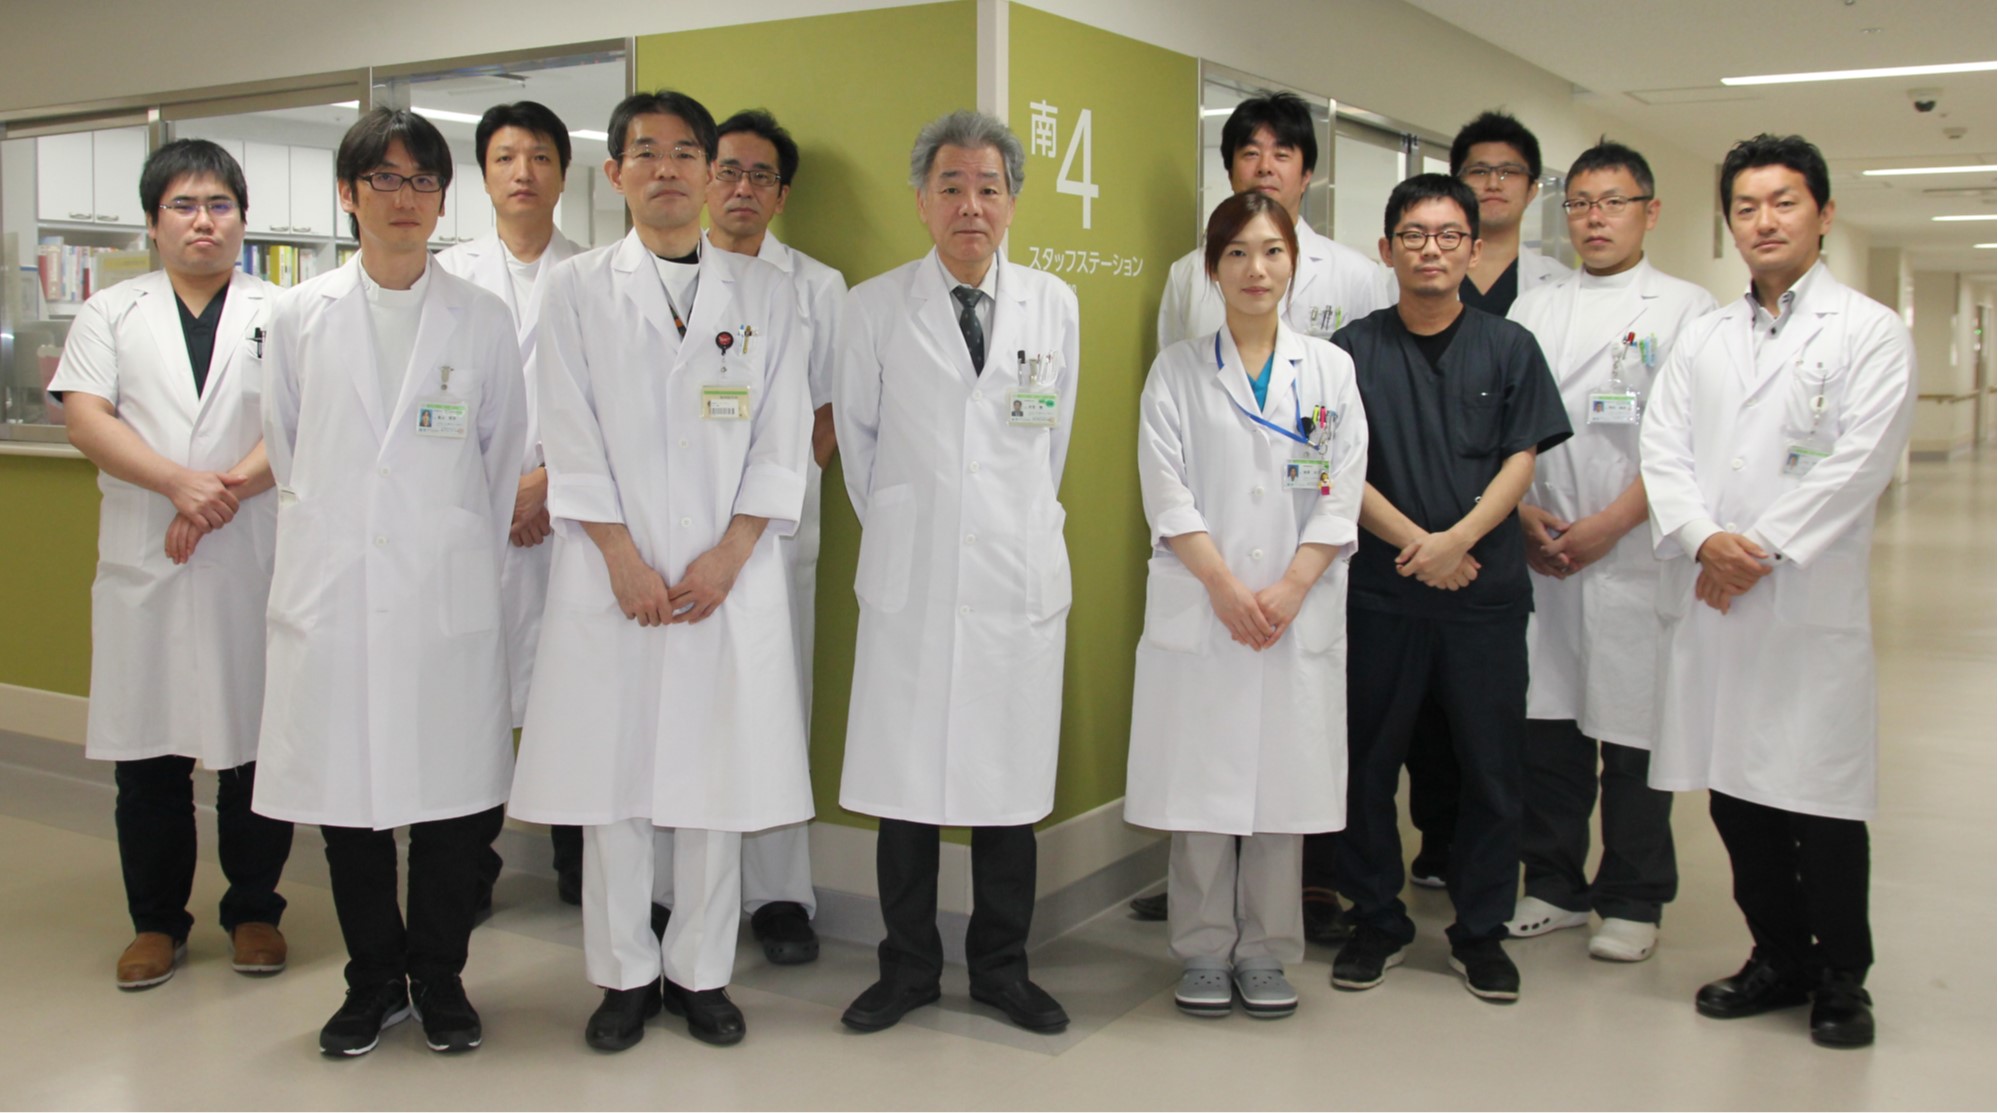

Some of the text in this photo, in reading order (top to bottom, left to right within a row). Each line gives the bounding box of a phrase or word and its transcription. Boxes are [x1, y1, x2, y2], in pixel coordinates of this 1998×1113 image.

[1028, 246, 1144, 277] スタッフステーション
